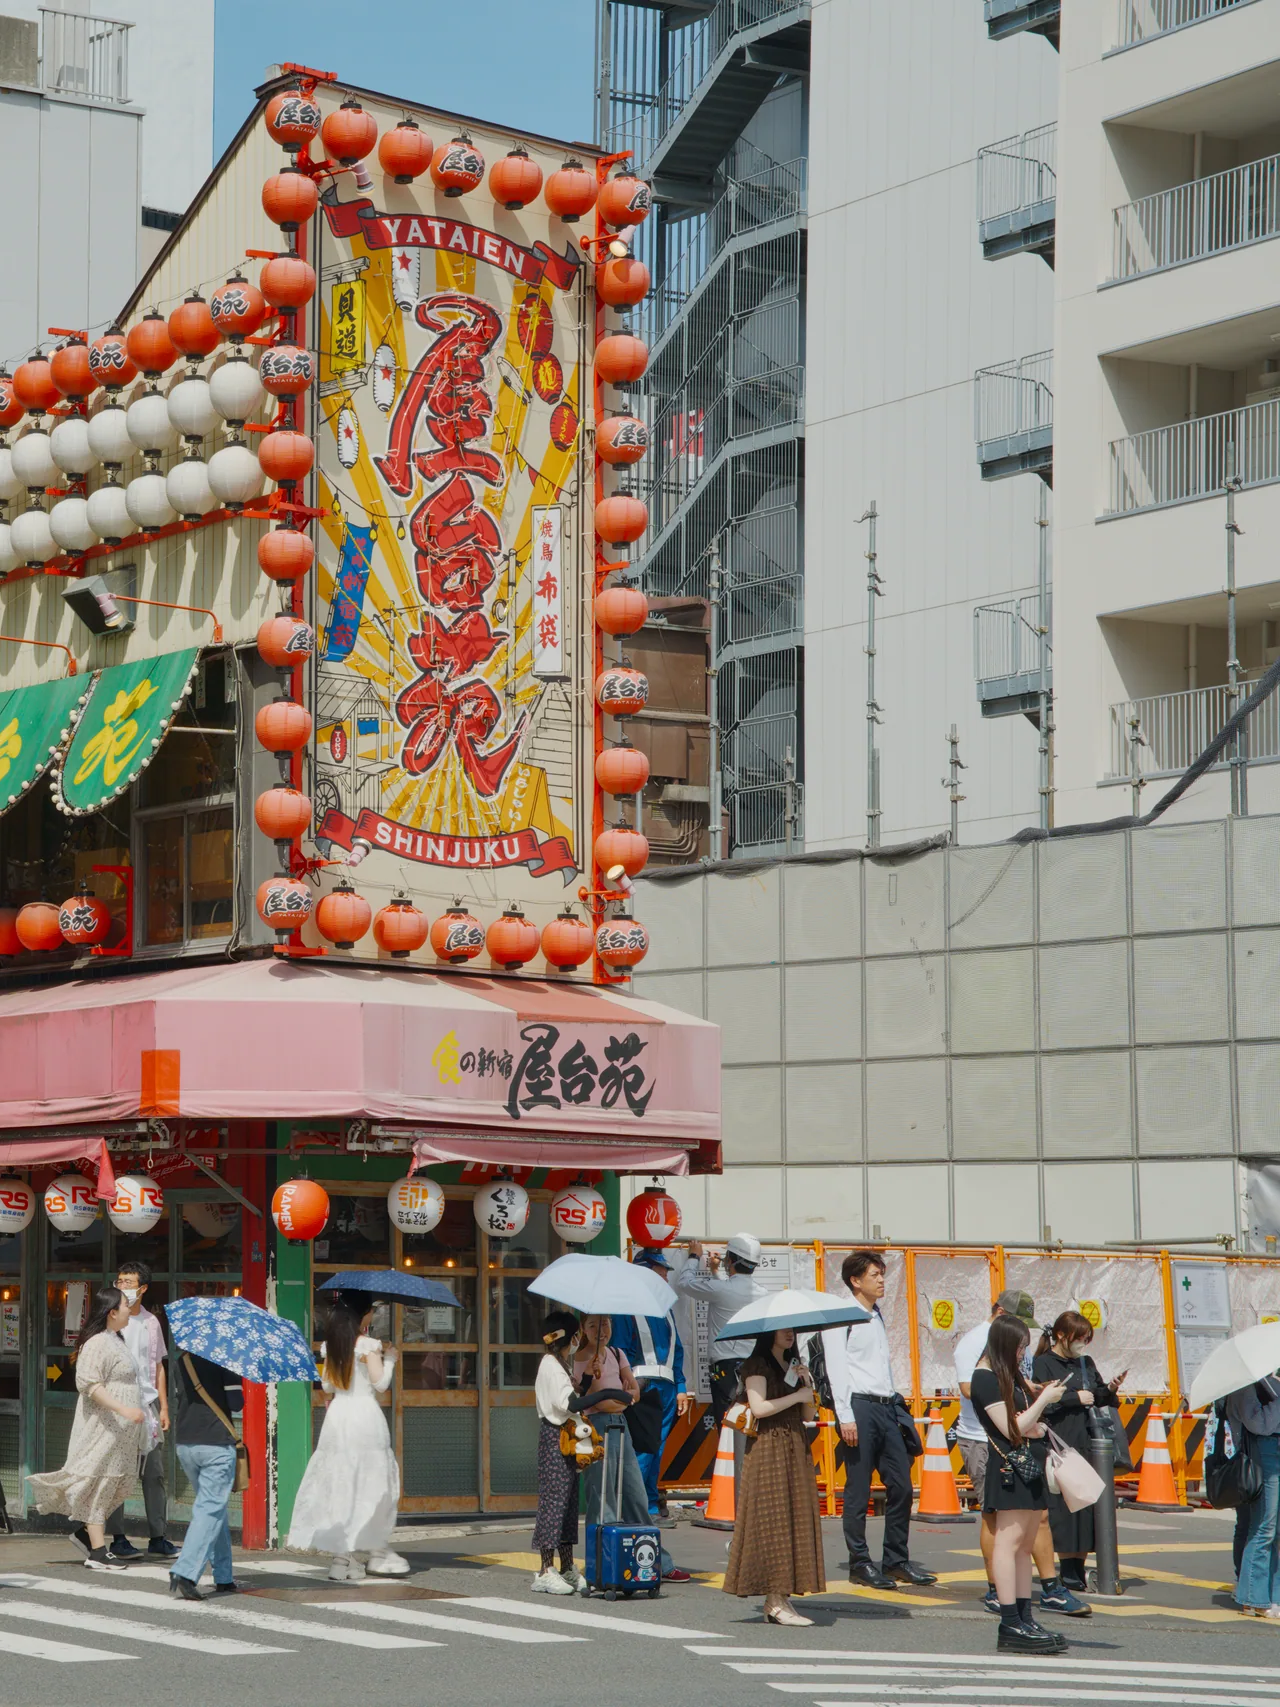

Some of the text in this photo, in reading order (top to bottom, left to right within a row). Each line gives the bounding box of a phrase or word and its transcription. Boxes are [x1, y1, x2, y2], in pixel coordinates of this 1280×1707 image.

[628, 185, 652, 212] 屋
[381, 218, 526, 276] YATAIEN
[335, 288, 359, 359] 貝道
[260, 351, 312, 380] 屋台苑
[374, 294, 530, 798] 屋台苑
[334, 731, 342, 759] TOKYO
[374, 822, 521, 864] SHINJUKU
[597, 926, 648, 953] 屋台苑
[431, 1023, 656, 1120] 食の新宿屋台苑
[281, 1186, 295, 1231] RAMEN
[487, 1187, 509, 1231] くろ松
[556, 1207, 586, 1226] RS
[703, 1414, 715, 1430] 安
[947, 1426, 958, 1441] 全
